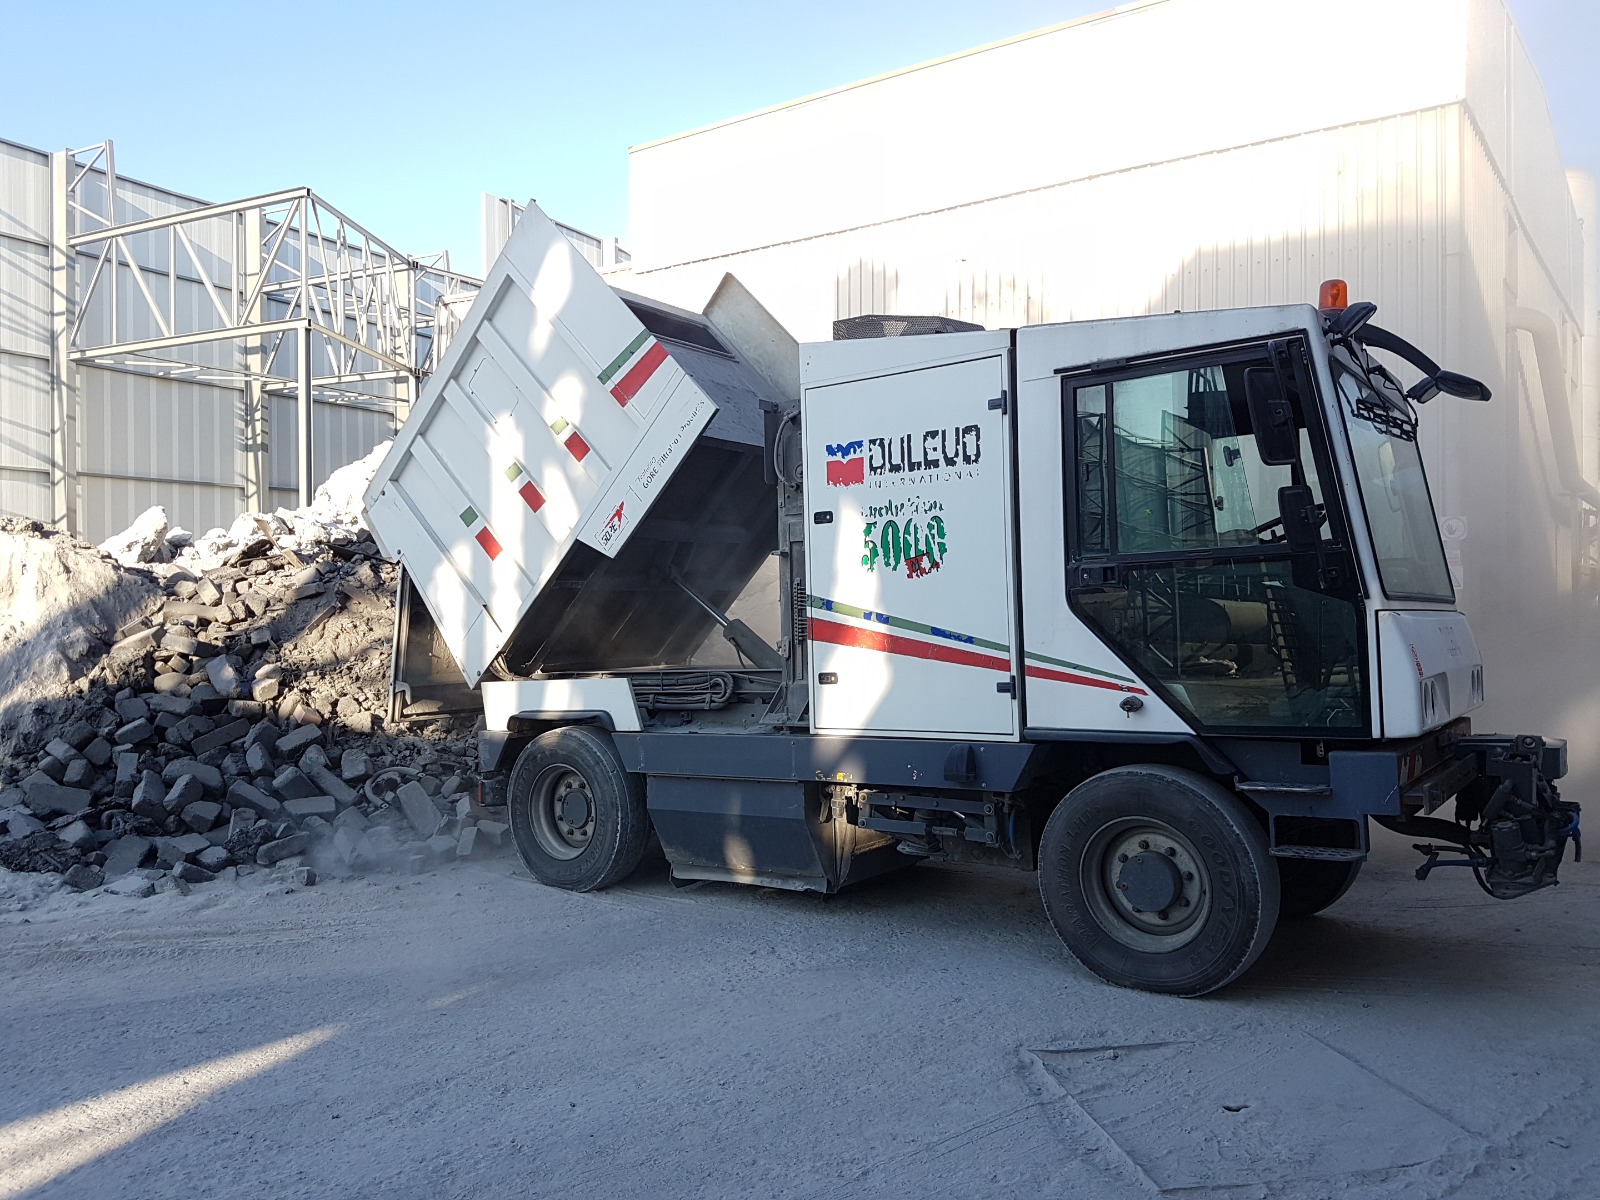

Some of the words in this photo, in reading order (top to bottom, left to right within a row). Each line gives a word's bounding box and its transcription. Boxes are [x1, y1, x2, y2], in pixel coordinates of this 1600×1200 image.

[868, 424, 981, 477] DULEVO
[642, 466, 659, 489] GORE
[868, 469, 982, 489] INRNATIONA
[860, 515, 948, 575] 5000
[1056, 844, 1094, 945] MARATHON
